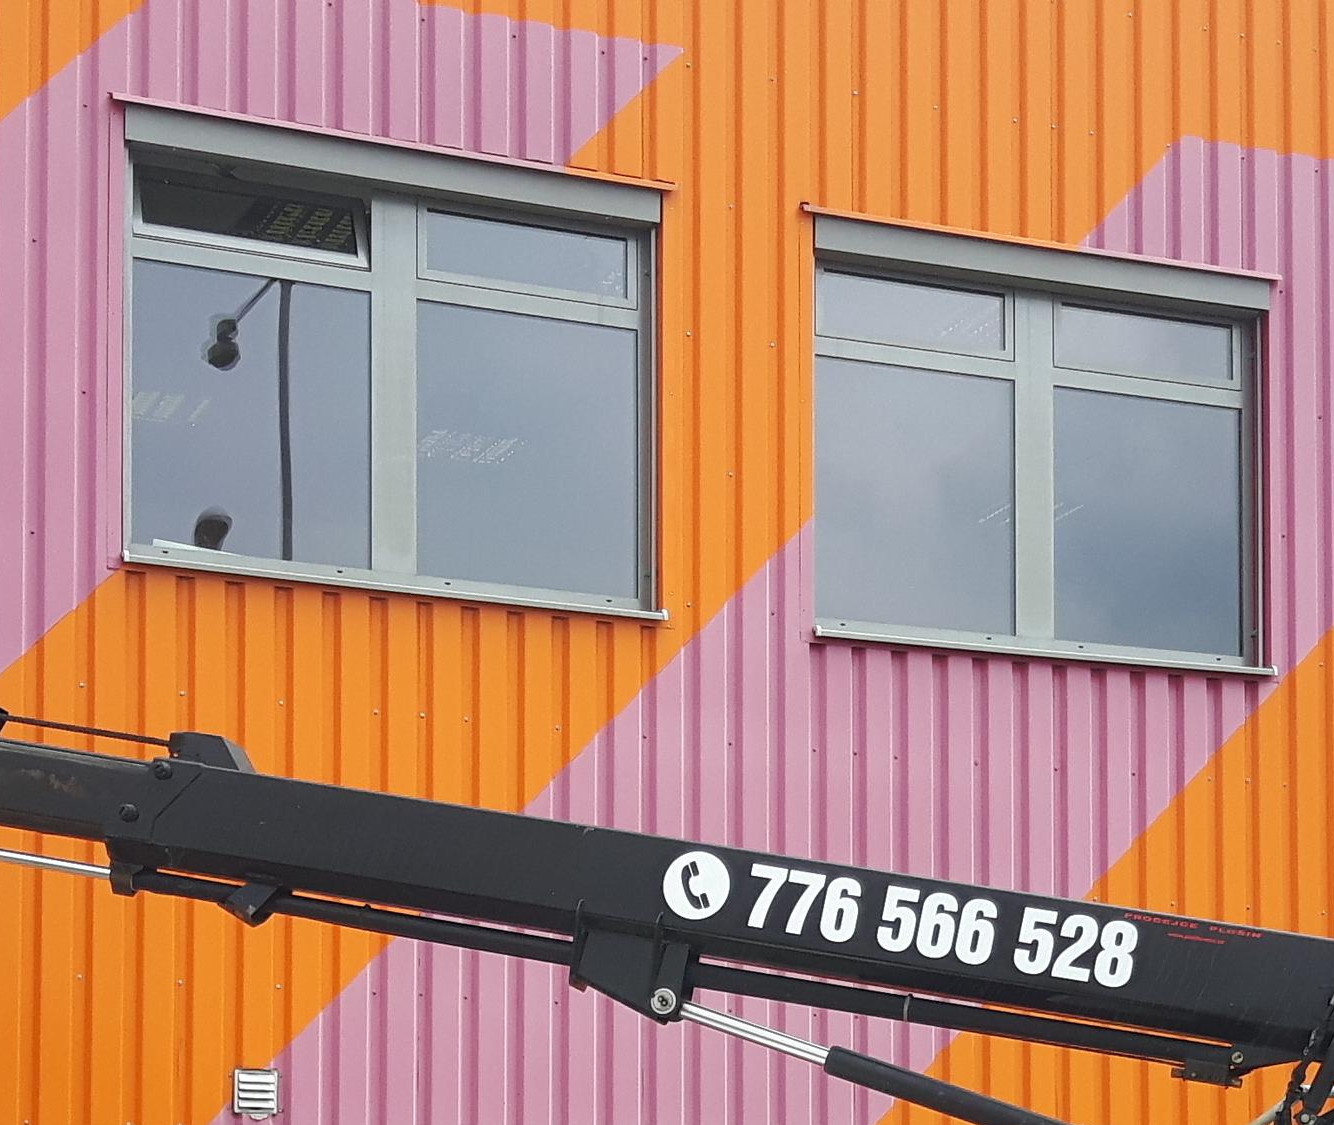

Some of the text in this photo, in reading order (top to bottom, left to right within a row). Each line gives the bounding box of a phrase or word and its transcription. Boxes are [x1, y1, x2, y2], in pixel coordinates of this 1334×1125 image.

[748, 862, 1140, 989] 776 566 528
